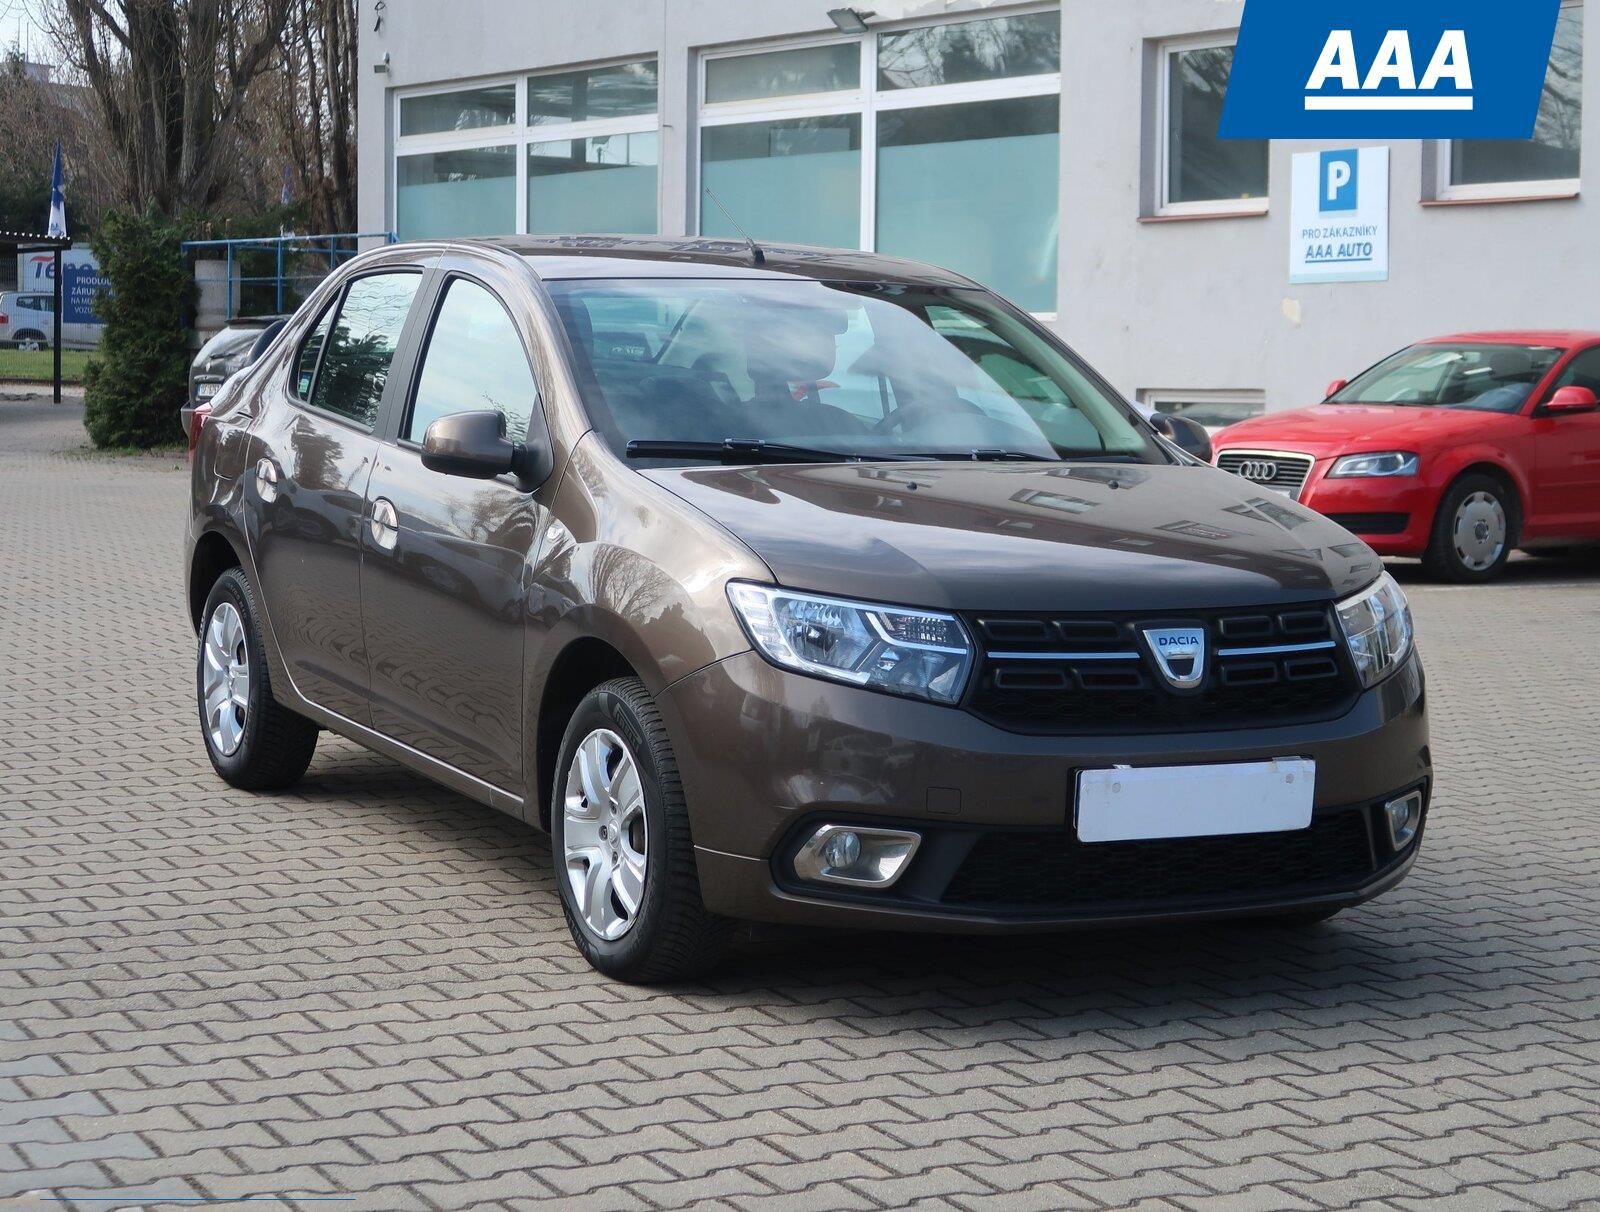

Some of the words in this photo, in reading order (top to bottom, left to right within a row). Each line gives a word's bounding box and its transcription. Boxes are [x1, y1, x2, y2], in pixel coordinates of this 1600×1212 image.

[1327, 160, 1351, 200] P
[1302, 228, 1321, 239] PRO
[1323, 224, 1378, 238] ZÁKAZNÍKY
[1305, 243, 1333, 258] AAA
[1337, 241, 1373, 257] AUTO
[76, 276, 112, 286] PRODLOU
[1158, 636, 1200, 646] DACIA
